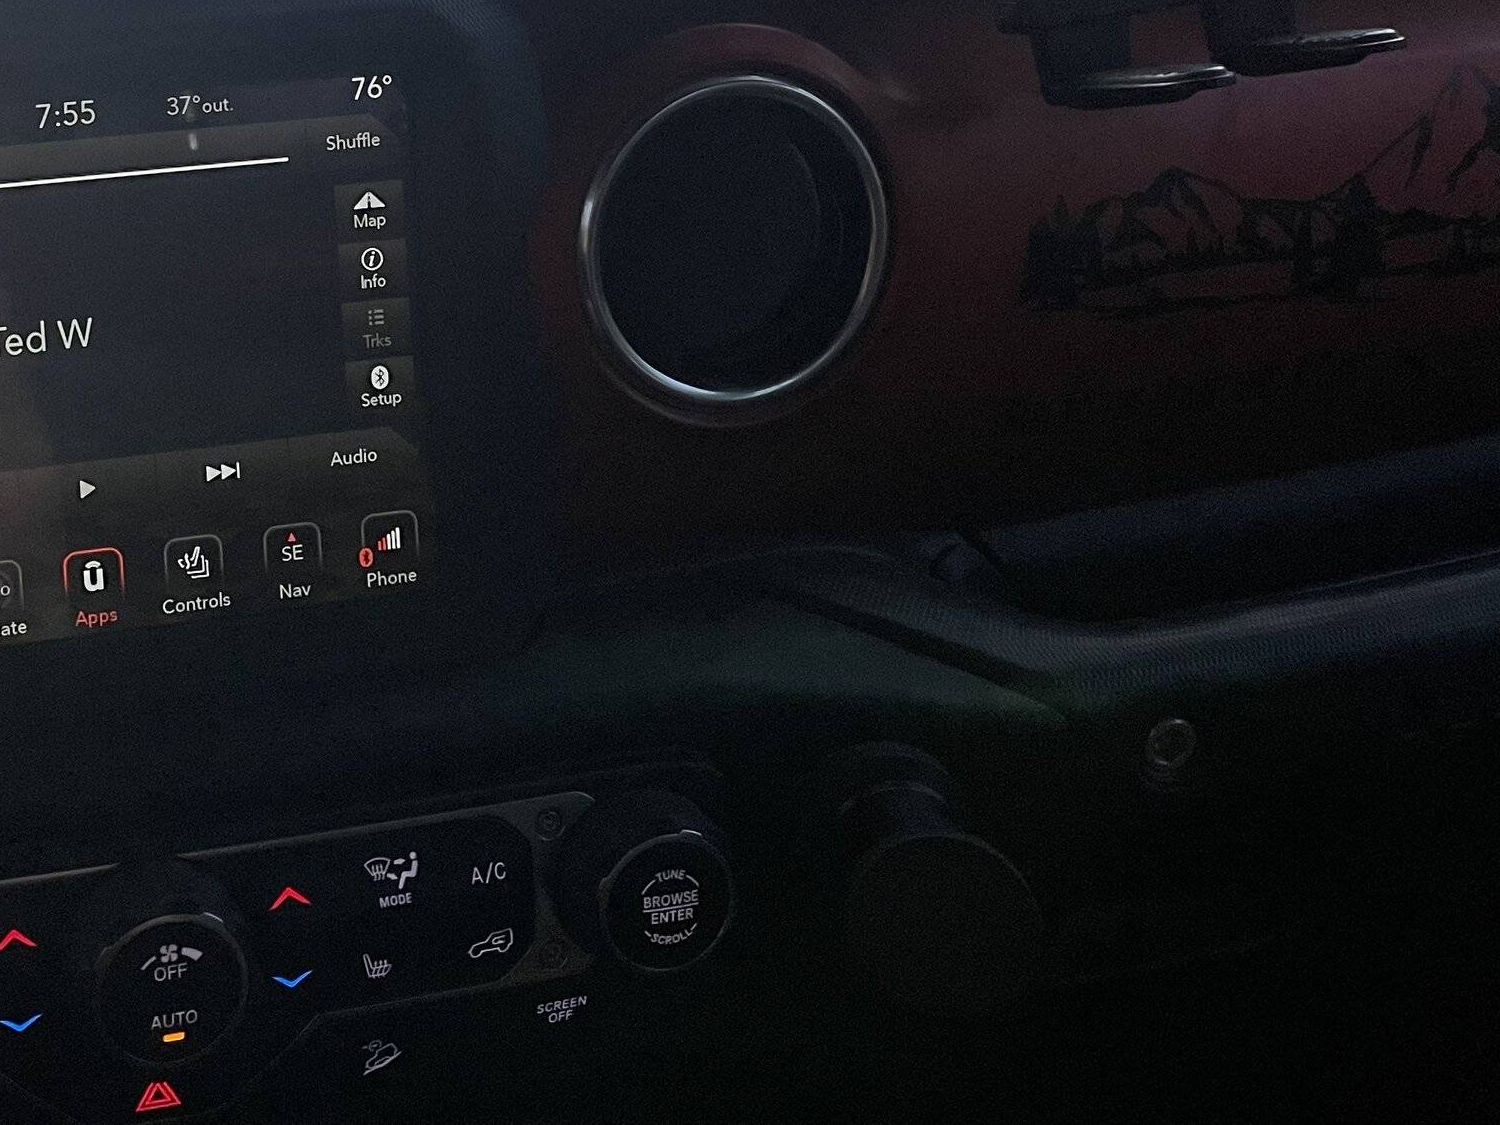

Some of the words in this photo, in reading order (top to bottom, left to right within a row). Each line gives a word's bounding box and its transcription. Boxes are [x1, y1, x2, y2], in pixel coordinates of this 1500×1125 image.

[352, 75, 391, 100] 76°
[36, 100, 95, 128] 7:55
[327, 132, 380, 150] Shuffle
[354, 214, 386, 229] Map
[361, 273, 386, 288] Info
[57, 318, 92, 349] W
[363, 333, 391, 348] Trks
[361, 390, 401, 407] Setup
[331, 448, 377, 466] Audio
[282, 544, 303, 561] SE
[366, 566, 417, 587] Phone
[280, 584, 310, 599] Nav
[163, 592, 230, 614] Controls
[76, 611, 117, 627] Apps
[472, 862, 506, 884] A/C
[655, 869, 686, 883] TUNE
[379, 893, 411, 907] MODE
[643, 889, 699, 909] BROWSE
[650, 906, 693, 925] ENTER
[650, 929, 693, 945] SCROLL
[153, 962, 187, 981] OFF
[537, 995, 587, 1015] SCREEN
[152, 1010, 197, 1028] AUTO
[548, 1007, 574, 1024] OFF
